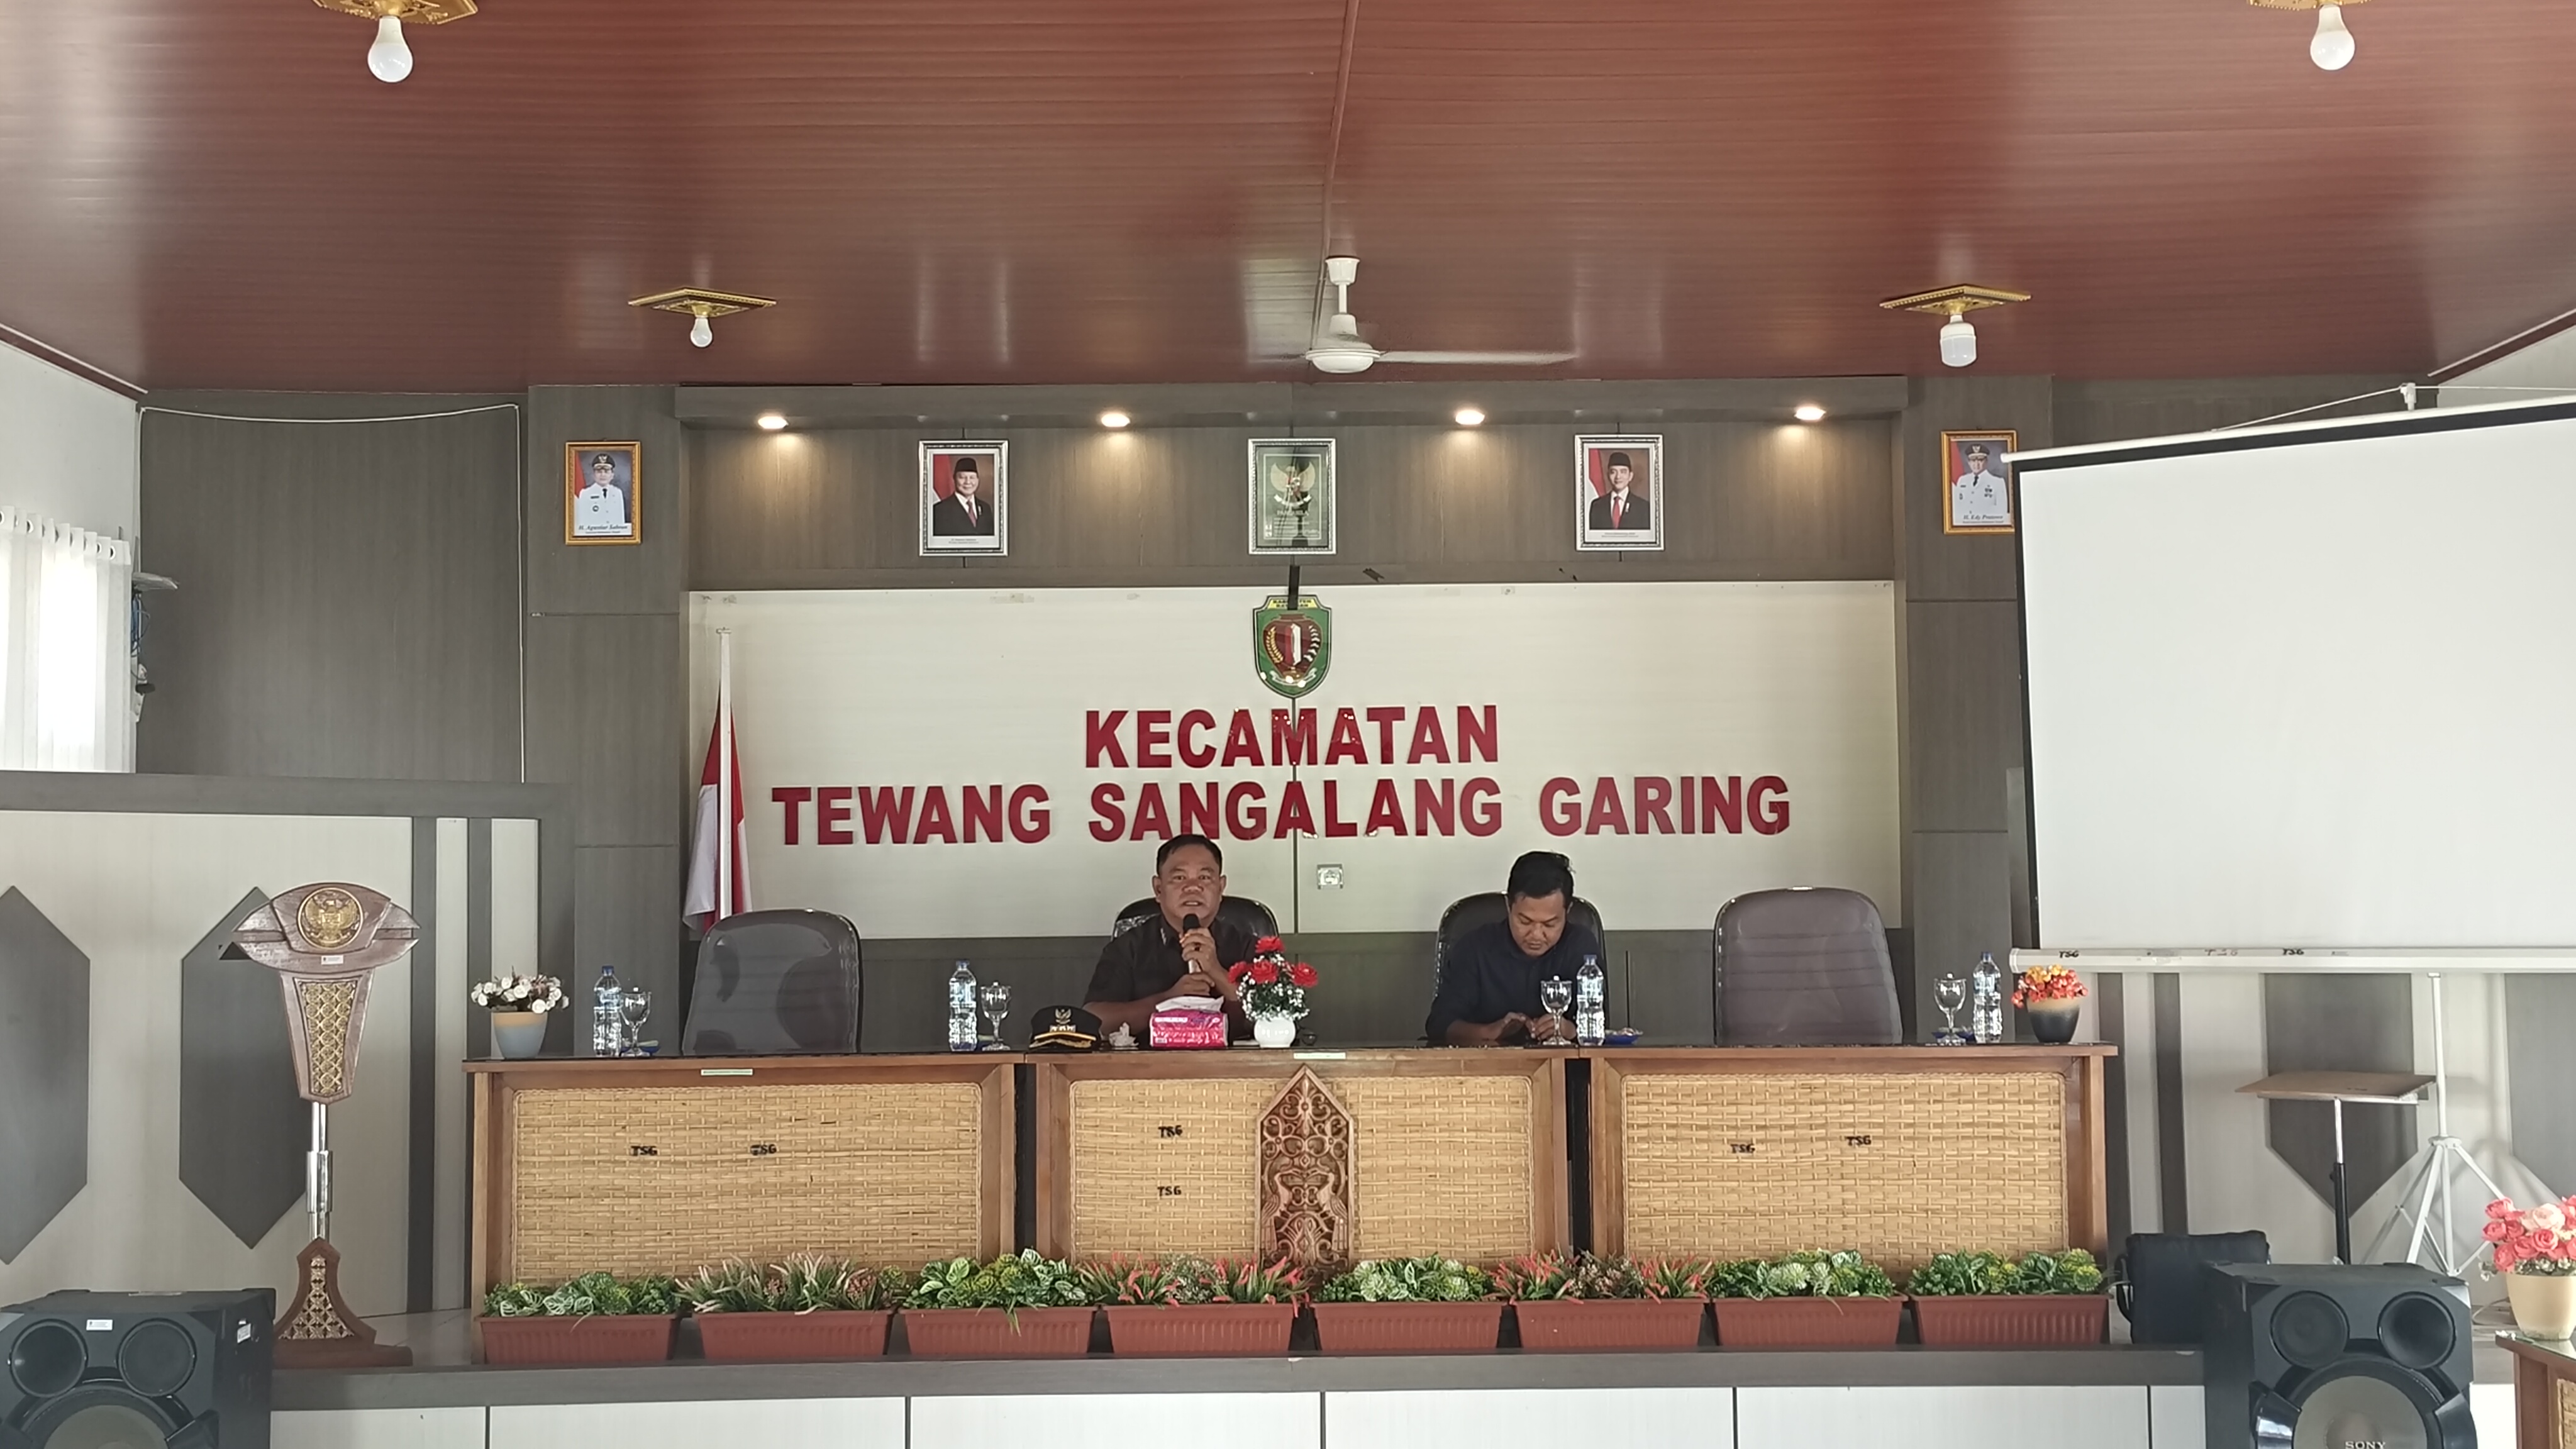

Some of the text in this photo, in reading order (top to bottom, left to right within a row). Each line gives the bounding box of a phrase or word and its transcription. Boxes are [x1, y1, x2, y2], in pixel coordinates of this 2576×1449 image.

[1086, 705, 1498, 769] KECAMATAN
[772, 775, 1790, 845] TEWANG SANGALANG GARING
[630, 1145, 658, 1157] TSG
[1157, 1185, 1182, 1197] TSG
[2345, 1441, 2386, 1449] SONY
